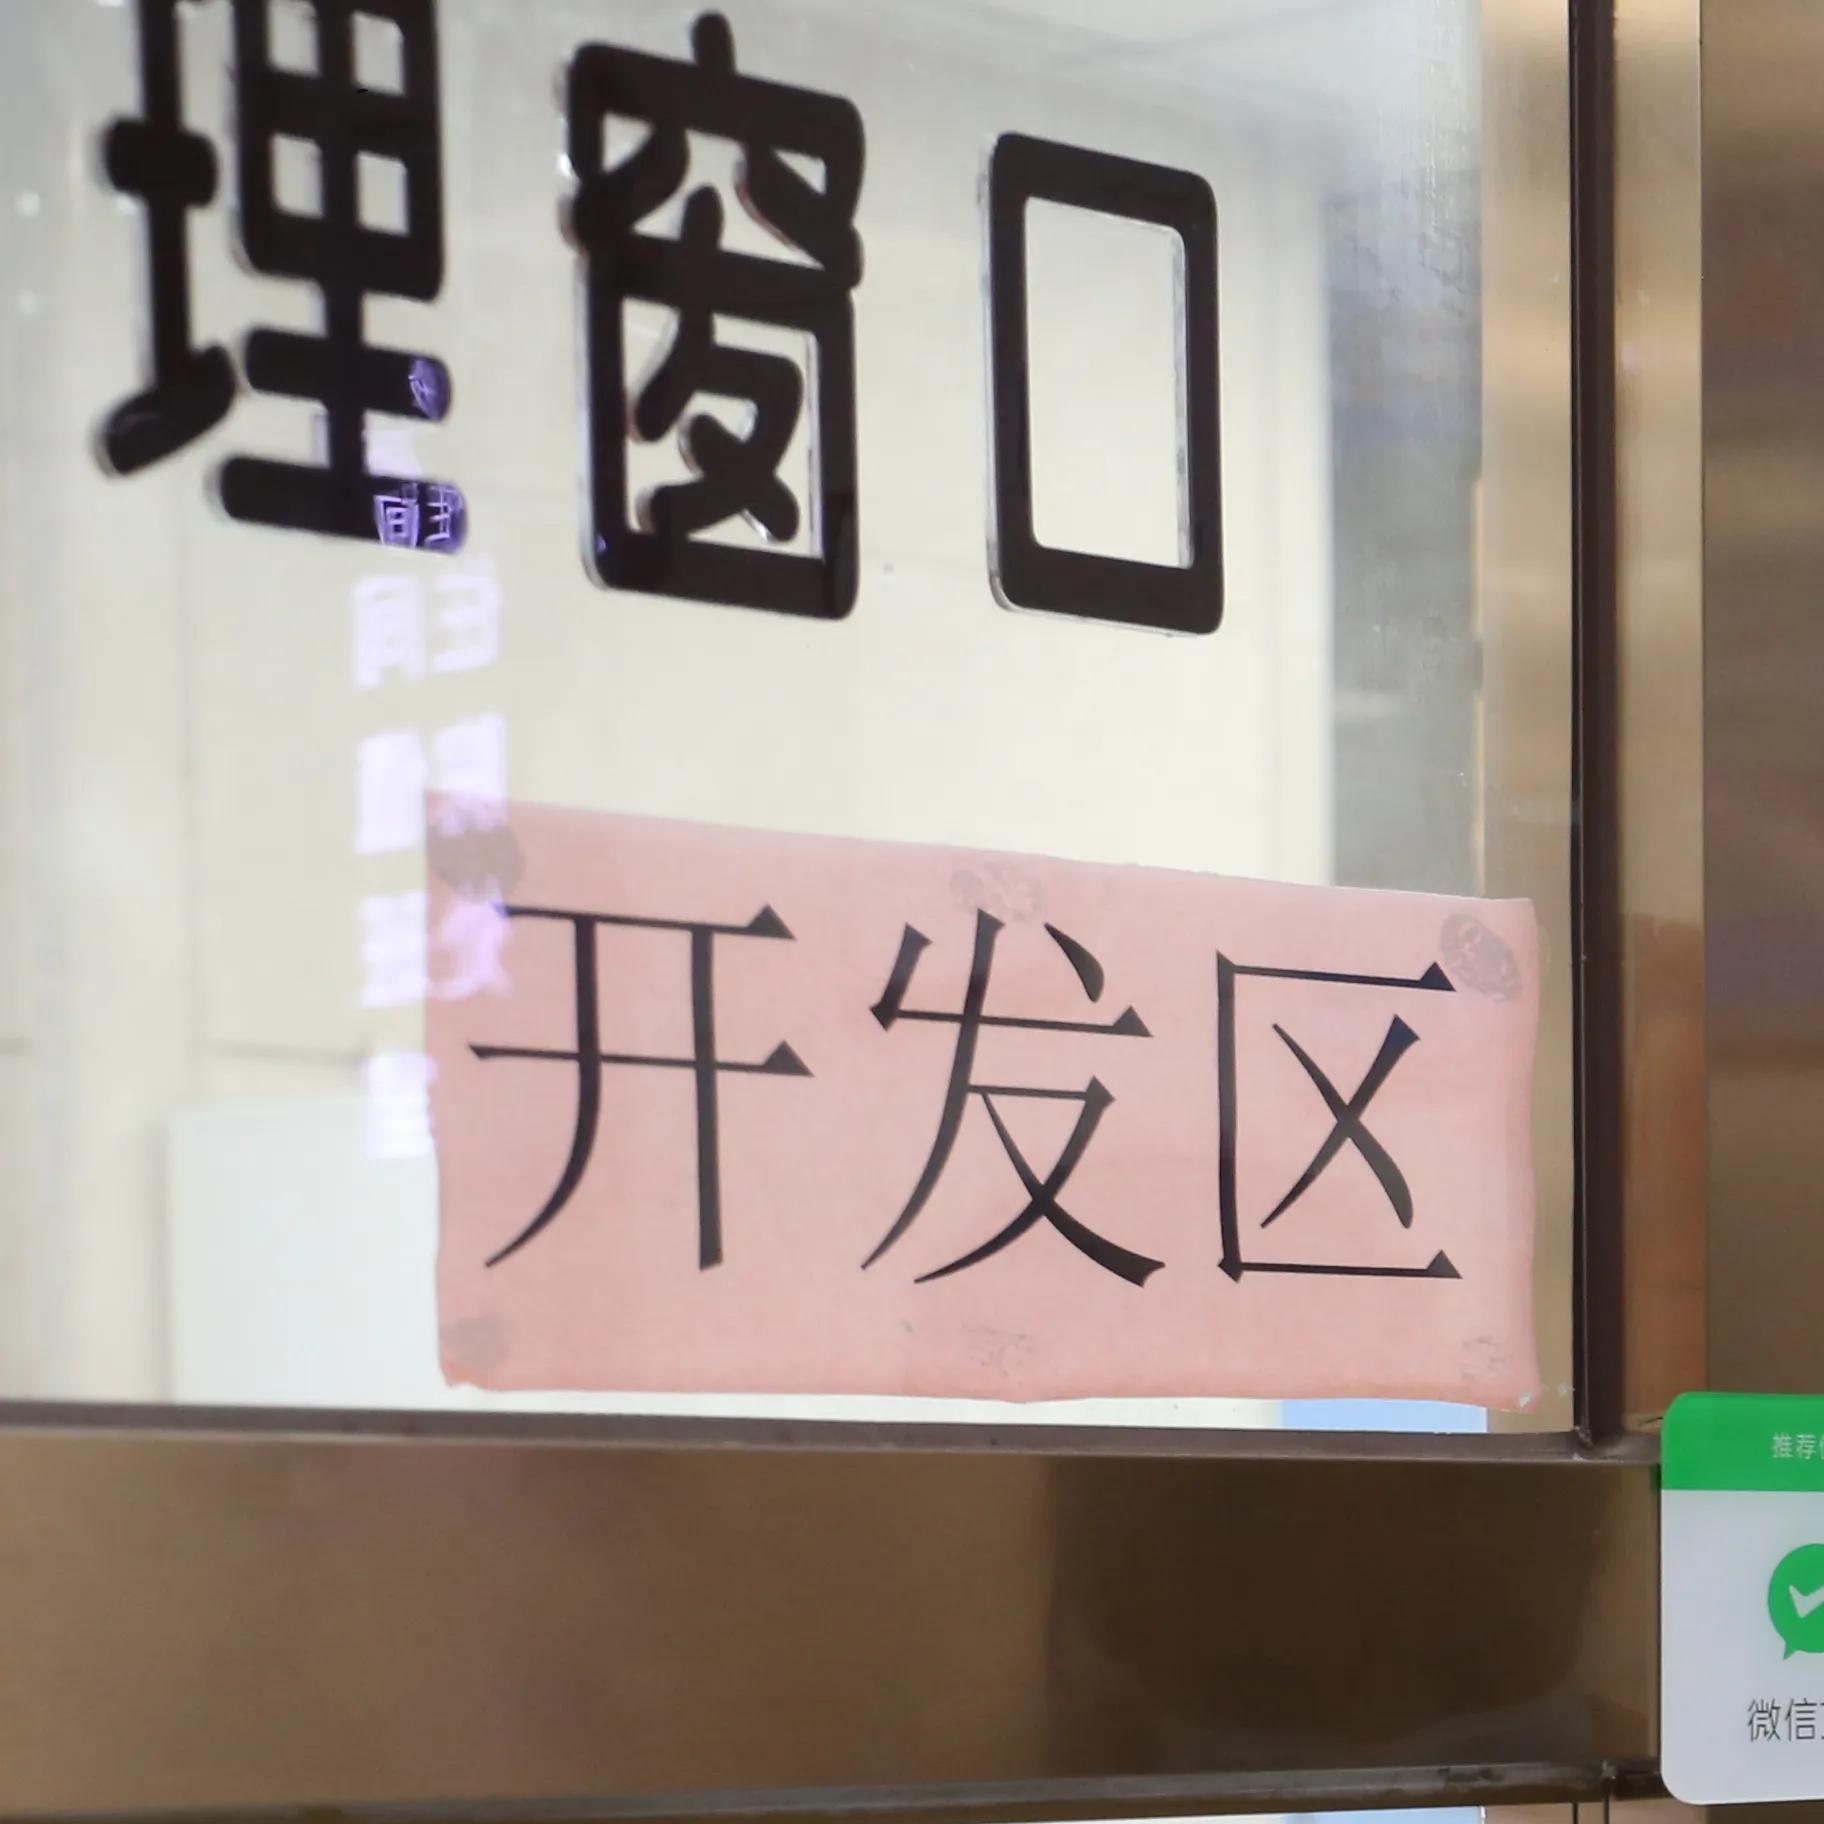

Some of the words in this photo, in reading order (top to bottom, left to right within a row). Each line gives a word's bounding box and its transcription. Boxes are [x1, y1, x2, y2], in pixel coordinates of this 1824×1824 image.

[93, 0, 1225, 636] 理窗口
[471, 904, 1464, 1290] 开发区
